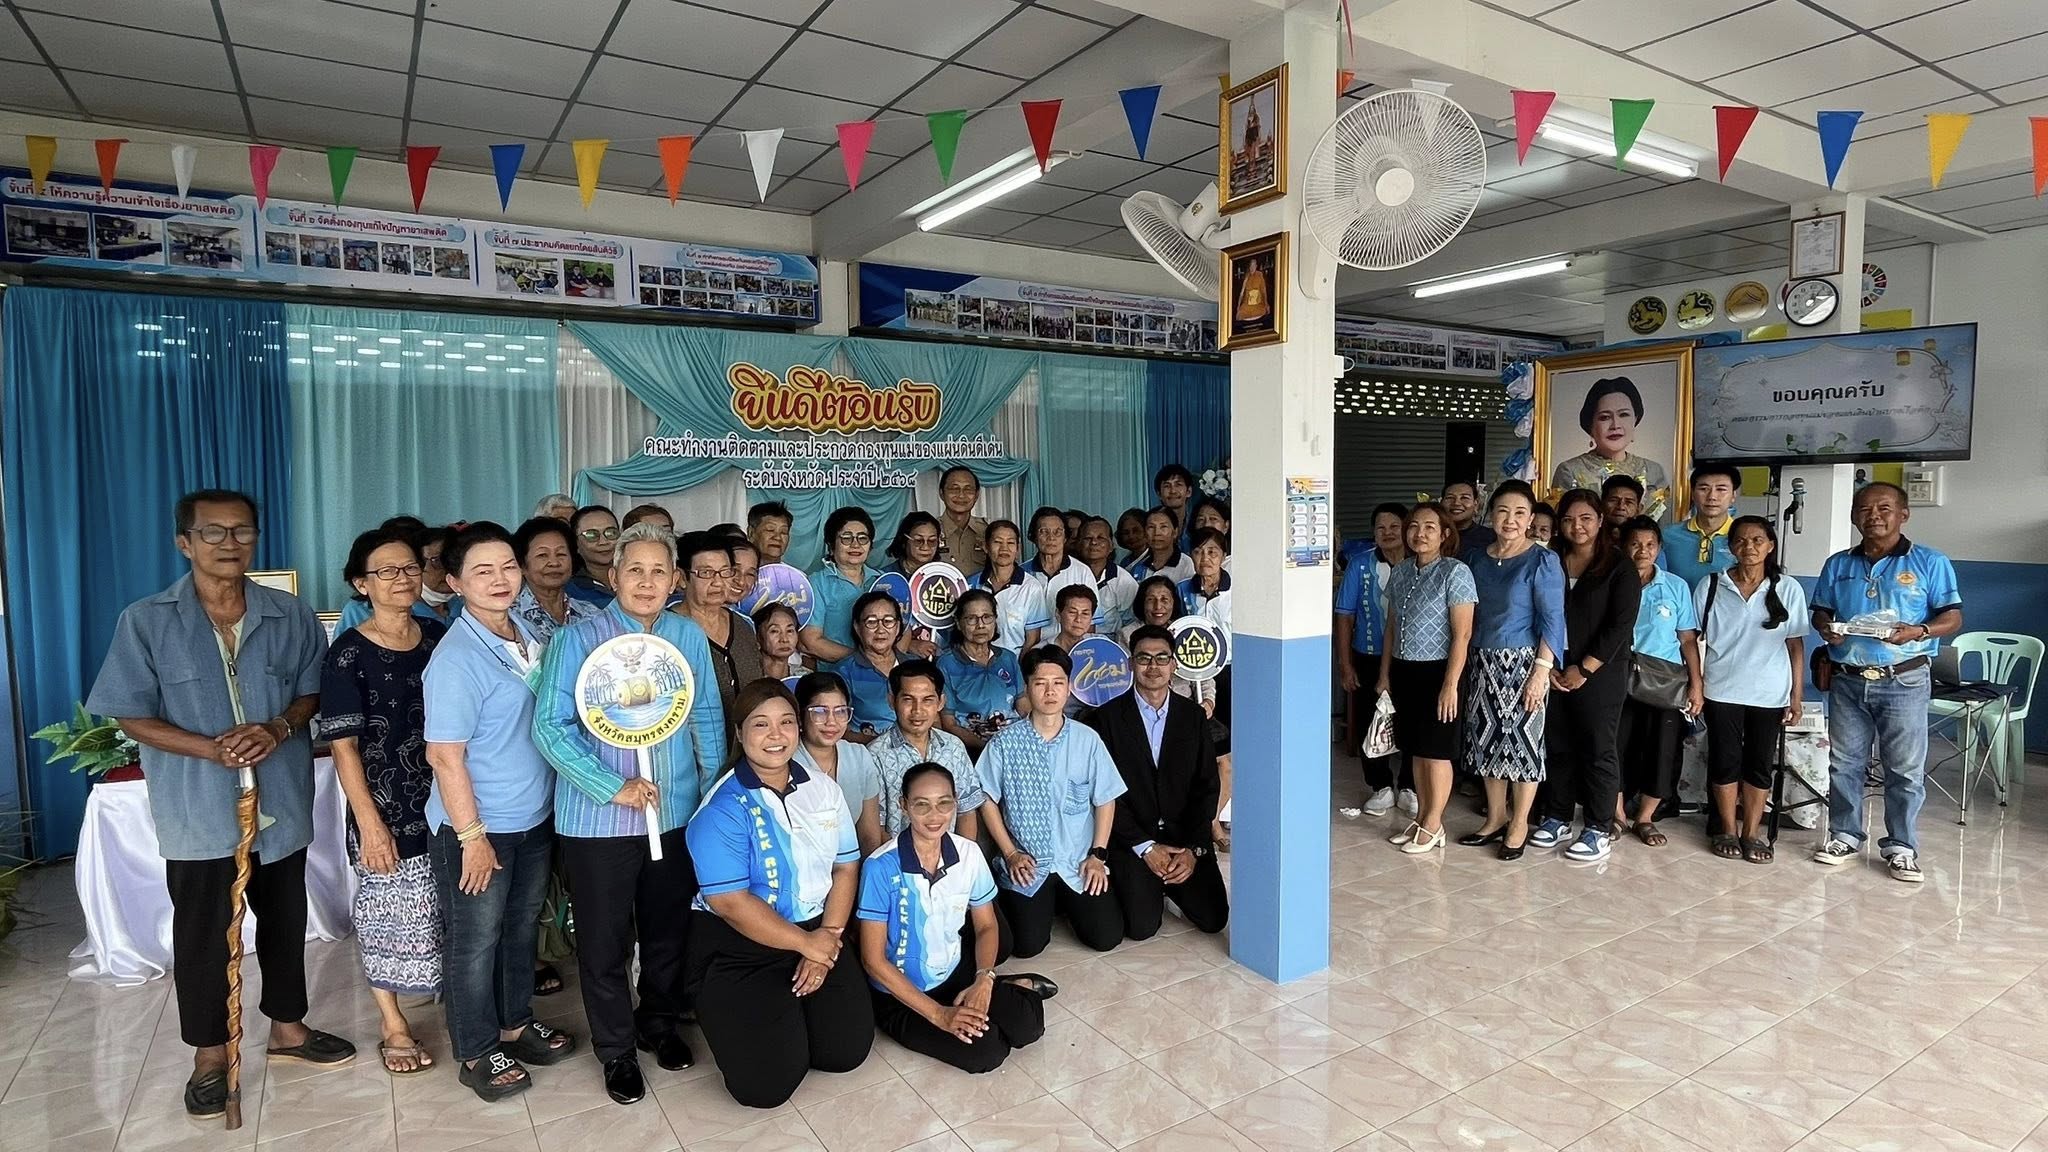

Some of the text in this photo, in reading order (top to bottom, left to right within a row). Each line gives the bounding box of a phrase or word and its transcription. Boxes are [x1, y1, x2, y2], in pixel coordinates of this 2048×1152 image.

[732, 365, 938, 430] ยินดีต้อนรับ
[1772, 380, 1886, 405] ขอบคุณครับ
[593, 697, 687, 745] จังหวัดสมุทรสงคราม
